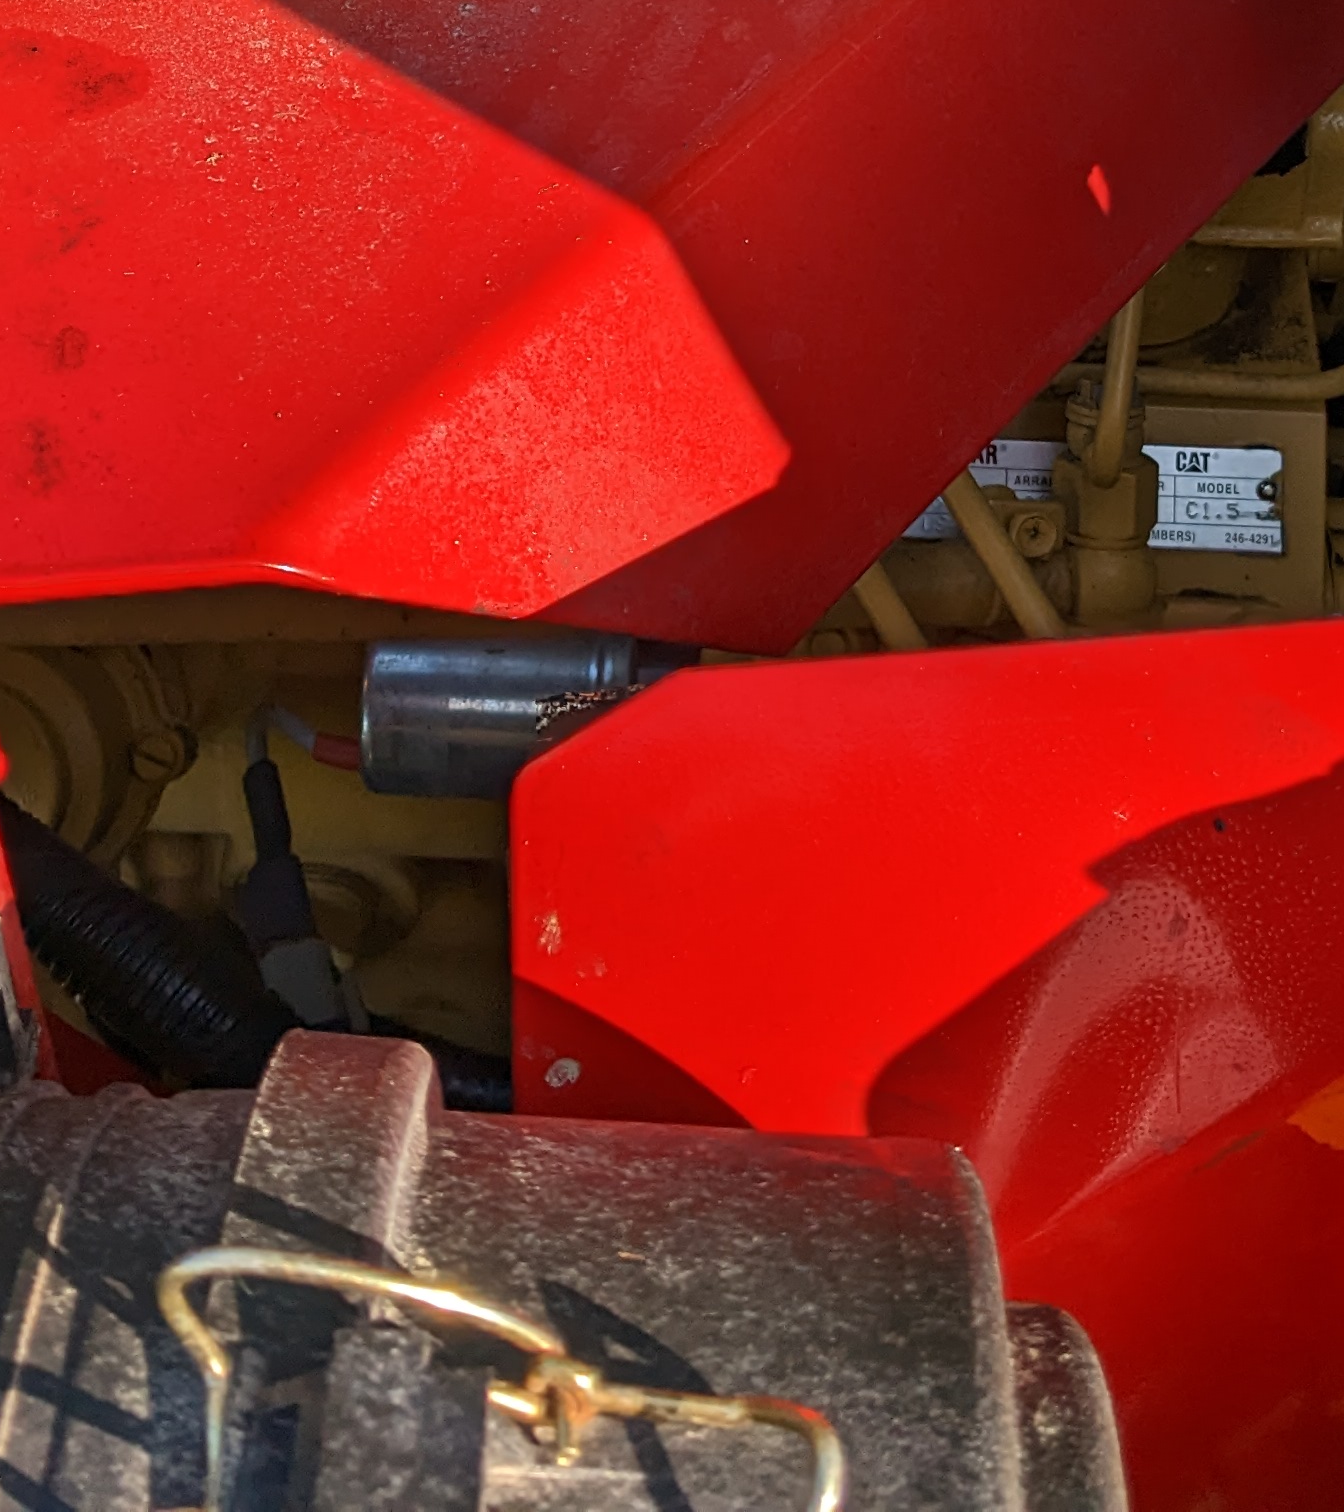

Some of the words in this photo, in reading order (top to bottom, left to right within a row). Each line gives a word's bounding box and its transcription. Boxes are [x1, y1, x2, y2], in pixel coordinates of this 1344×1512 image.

[1175, 451, 1211, 474] CAT
[1013, 475, 1053, 487] ARRA
[1197, 482, 1240, 495] MODEL
[1185, 501, 1240, 520] C1.5
[1151, 530, 1196, 544] MBERS)
[1224, 532, 1275, 545] 246-4291
